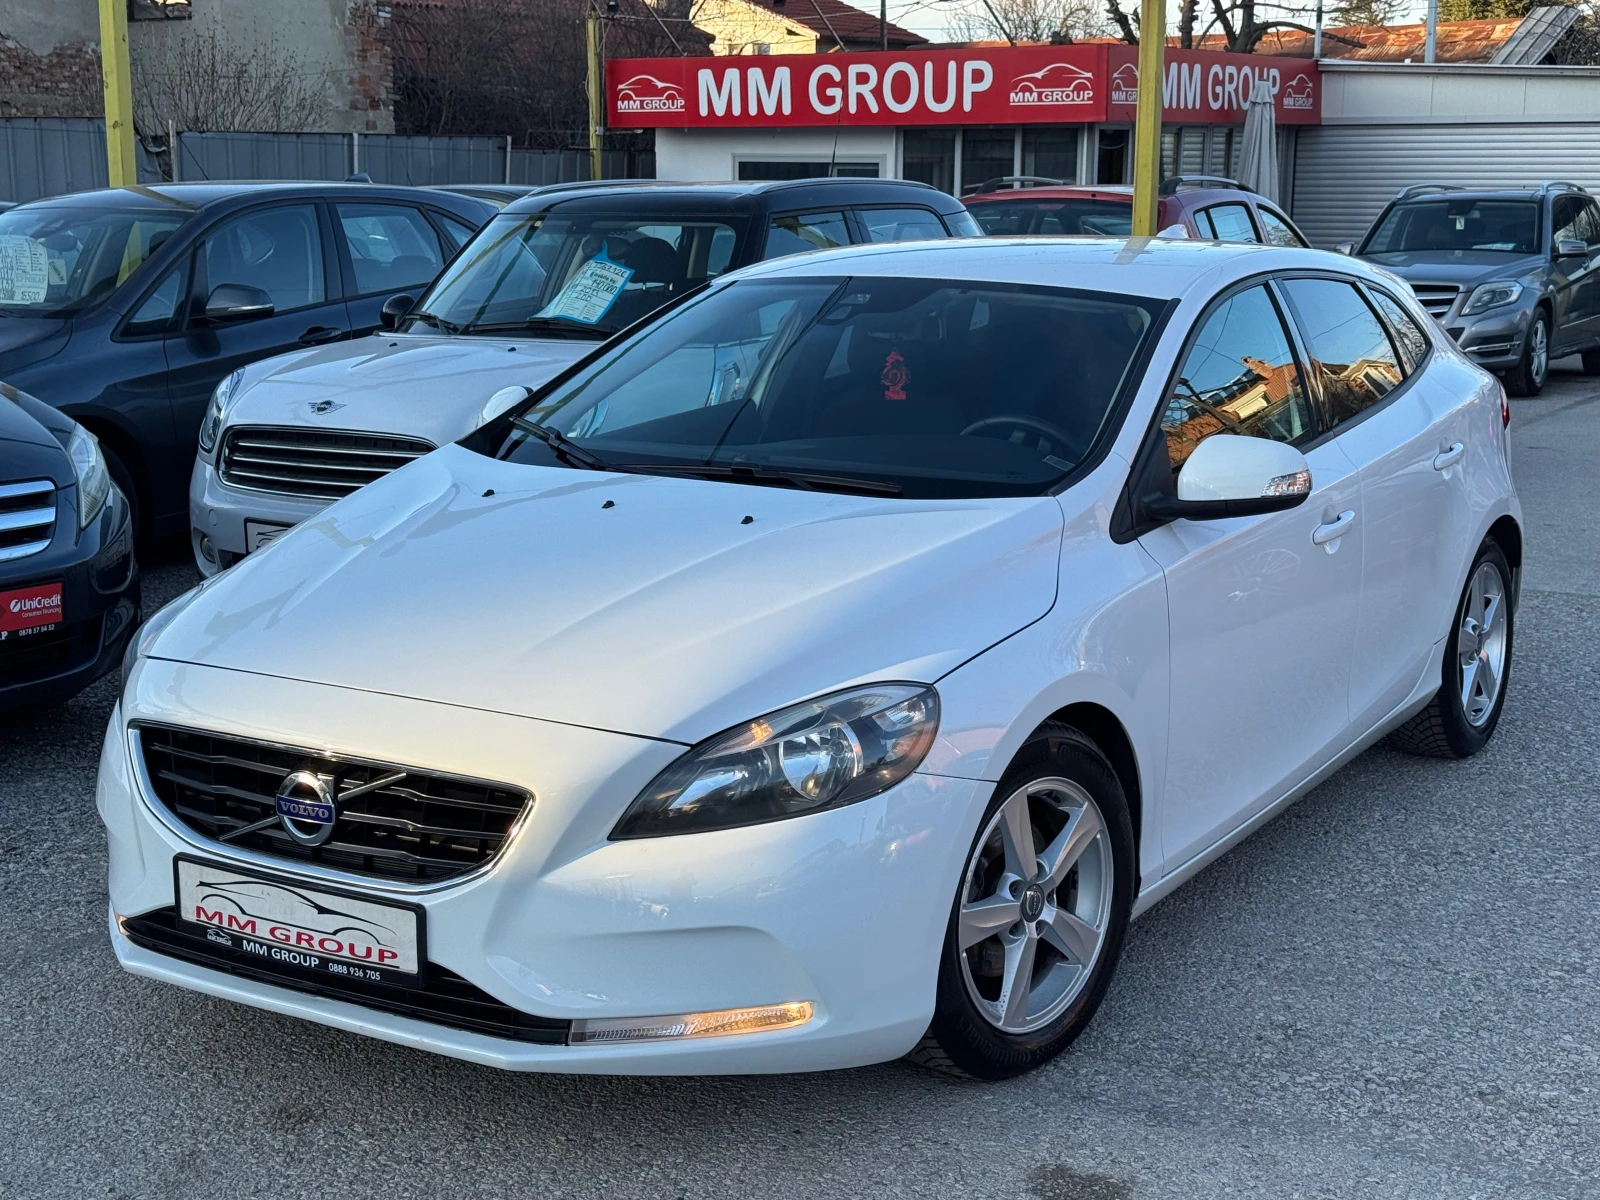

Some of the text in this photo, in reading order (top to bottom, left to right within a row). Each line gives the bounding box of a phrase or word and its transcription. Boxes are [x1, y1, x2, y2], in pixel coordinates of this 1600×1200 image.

[698, 60, 994, 117] MM GROUP
[1163, 62, 1202, 110] MM
[1009, 90, 1094, 103] MM GROUP
[1112, 91, 1126, 102] MM
[1295, 97, 1313, 107] GROUP
[617, 99, 685, 110] MM GROUP
[21, 594, 62, 611] UniCredit
[22, 607, 61, 618] Consumer Financing
[19, 623, 55, 637] 0878 57 54 52
[278, 800, 329, 819] VOLVO
[196, 905, 256, 934] MM
[269, 926, 398, 963] GROUP
[242, 940, 268, 957] MM
[271, 947, 319, 968] GROUP
[328, 962, 348, 975] 0888
[349, 967, 364, 978] 936
[366, 969, 381, 981] 705
